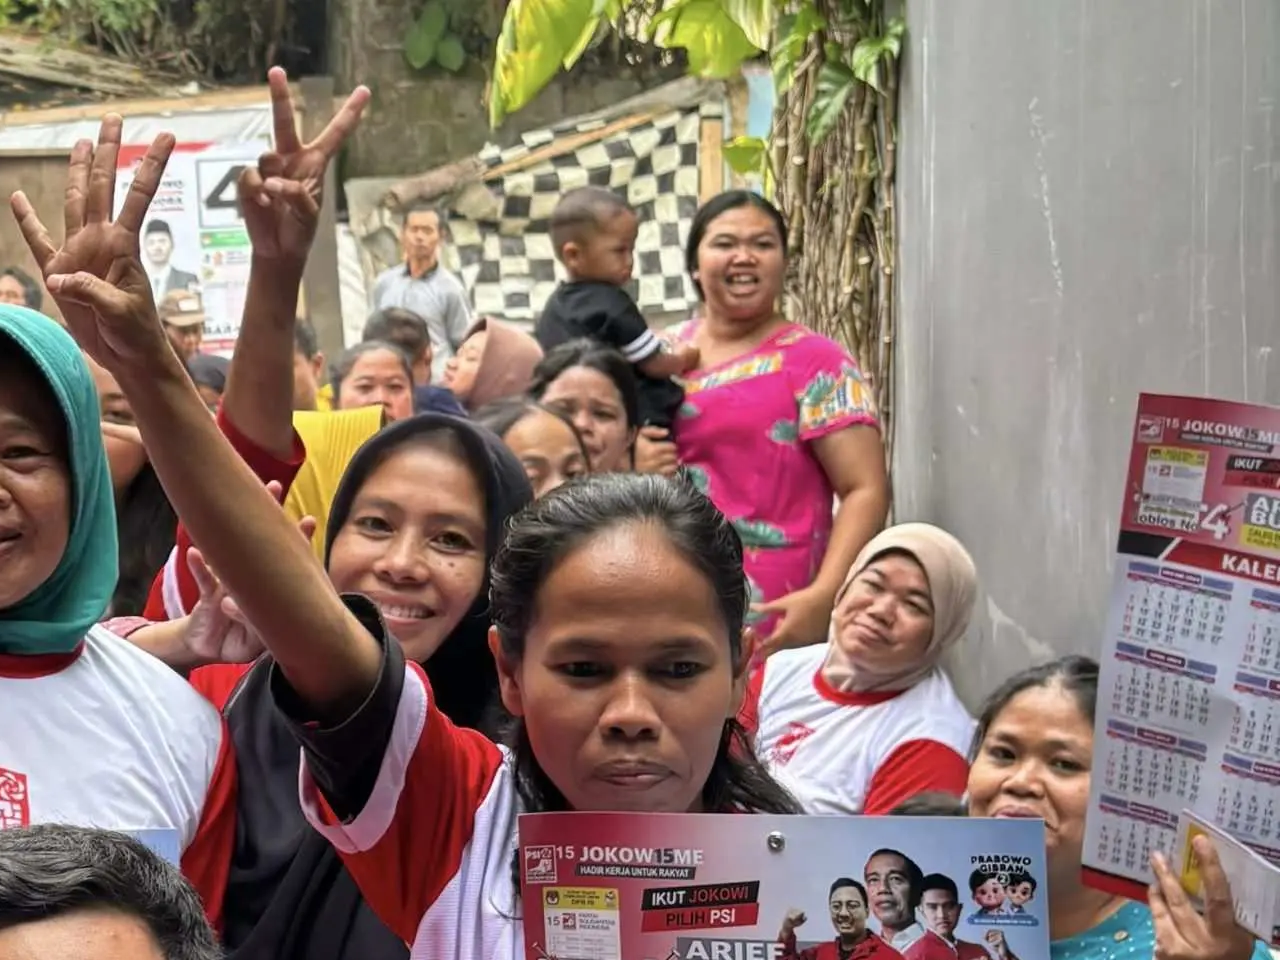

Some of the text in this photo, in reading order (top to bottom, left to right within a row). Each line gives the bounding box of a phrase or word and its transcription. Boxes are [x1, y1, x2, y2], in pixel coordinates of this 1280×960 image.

[1234, 458, 1263, 470] IKUT
[1201, 503, 1231, 540] 4
[1222, 554, 1280, 581] KALE
[556, 846, 574, 859] 15
[971, 855, 1032, 866] PRABOWO
[580, 865, 689, 878] HADIR KERJA UNTUK RAKYAT
[980, 863, 1024, 874] GIBRAN
[651, 886, 749, 905] IKUT JOKOWI
[547, 916, 560, 926] 15
[666, 908, 735, 927] PILIH PSI
